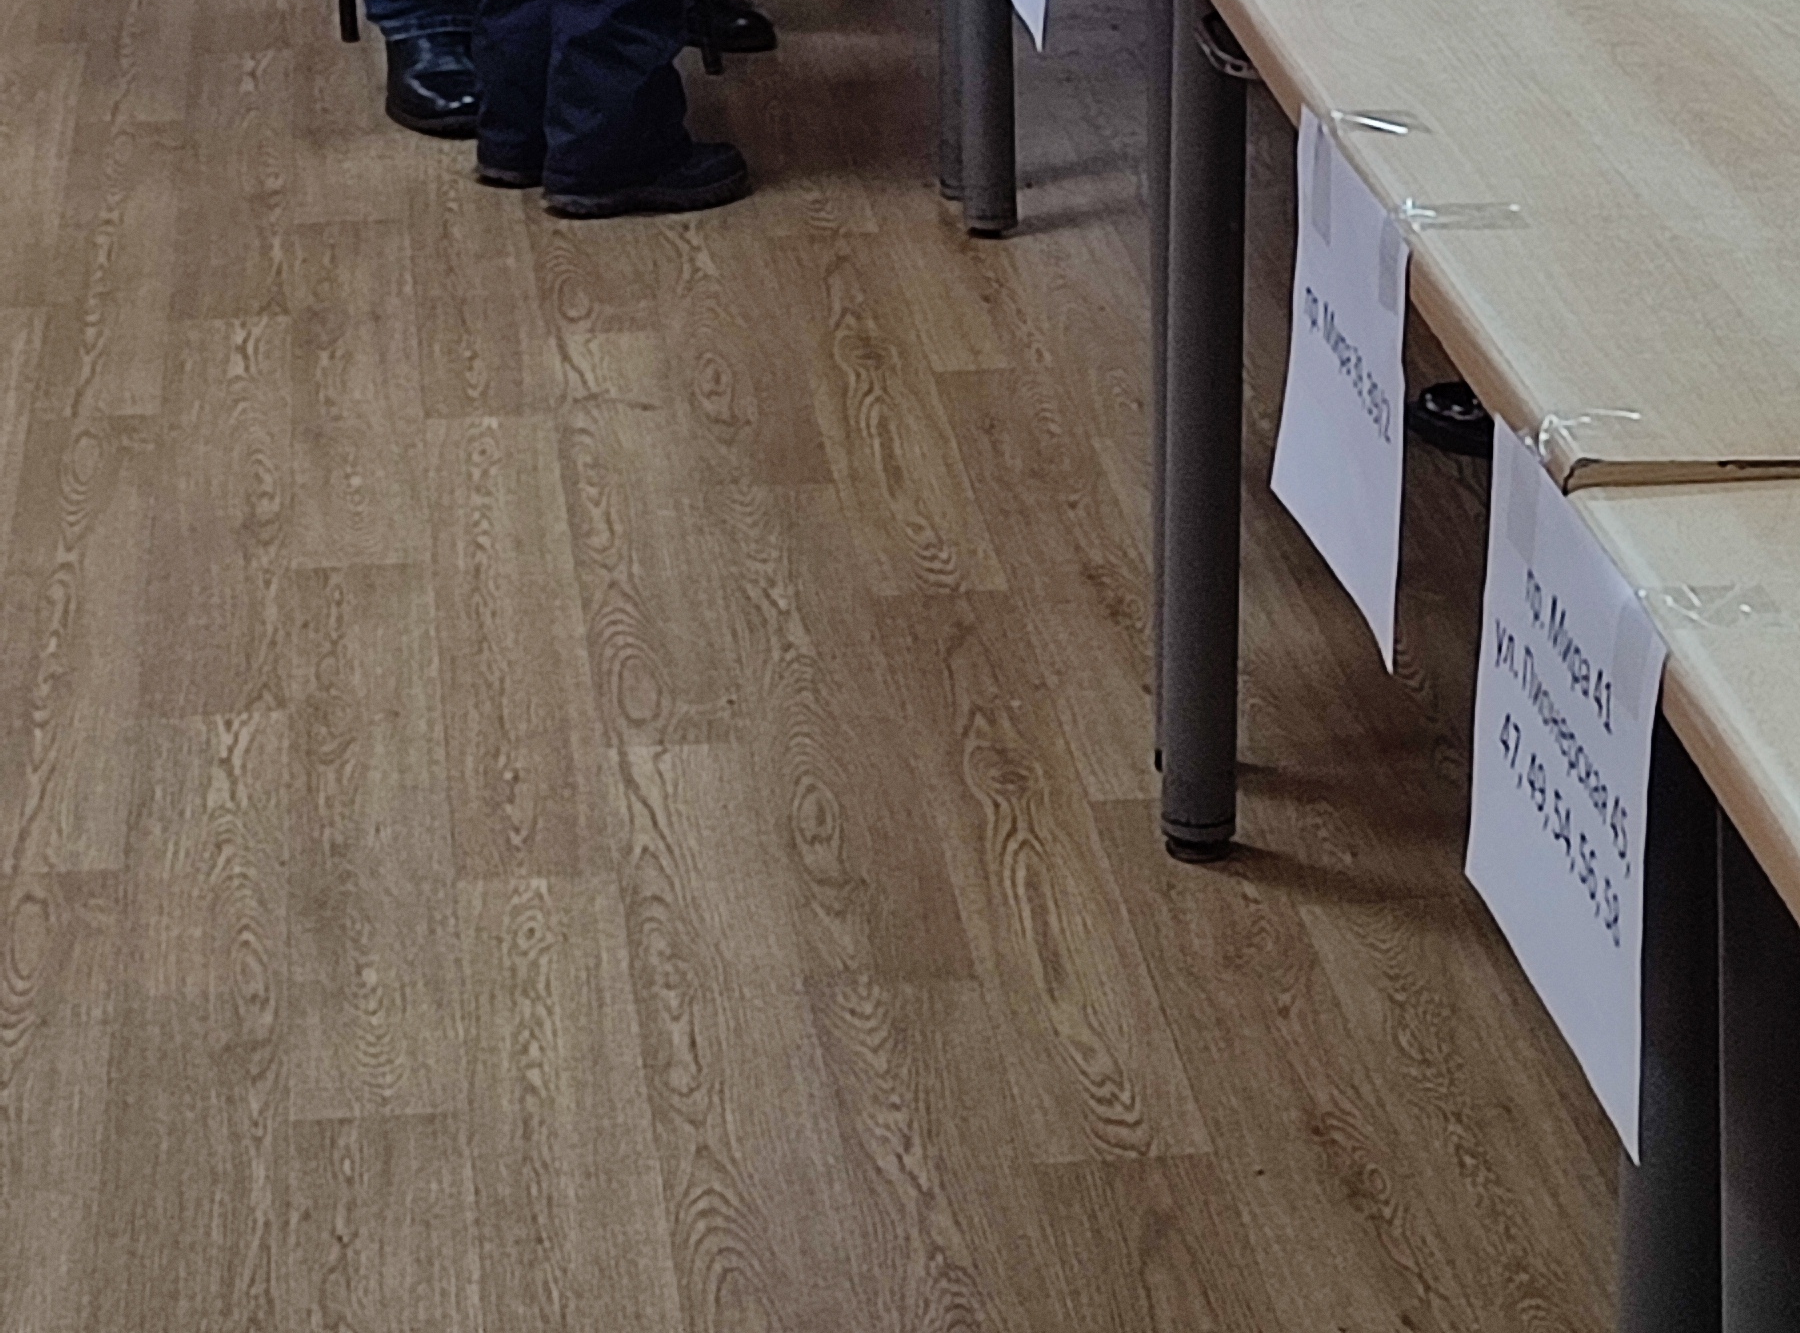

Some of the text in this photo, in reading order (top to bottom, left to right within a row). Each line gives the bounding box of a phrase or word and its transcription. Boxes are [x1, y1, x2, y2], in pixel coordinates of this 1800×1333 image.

[1495, 618, 1632, 879] ул. Пионерская 45,
[1526, 567, 1613, 734] пр. Мира 41
